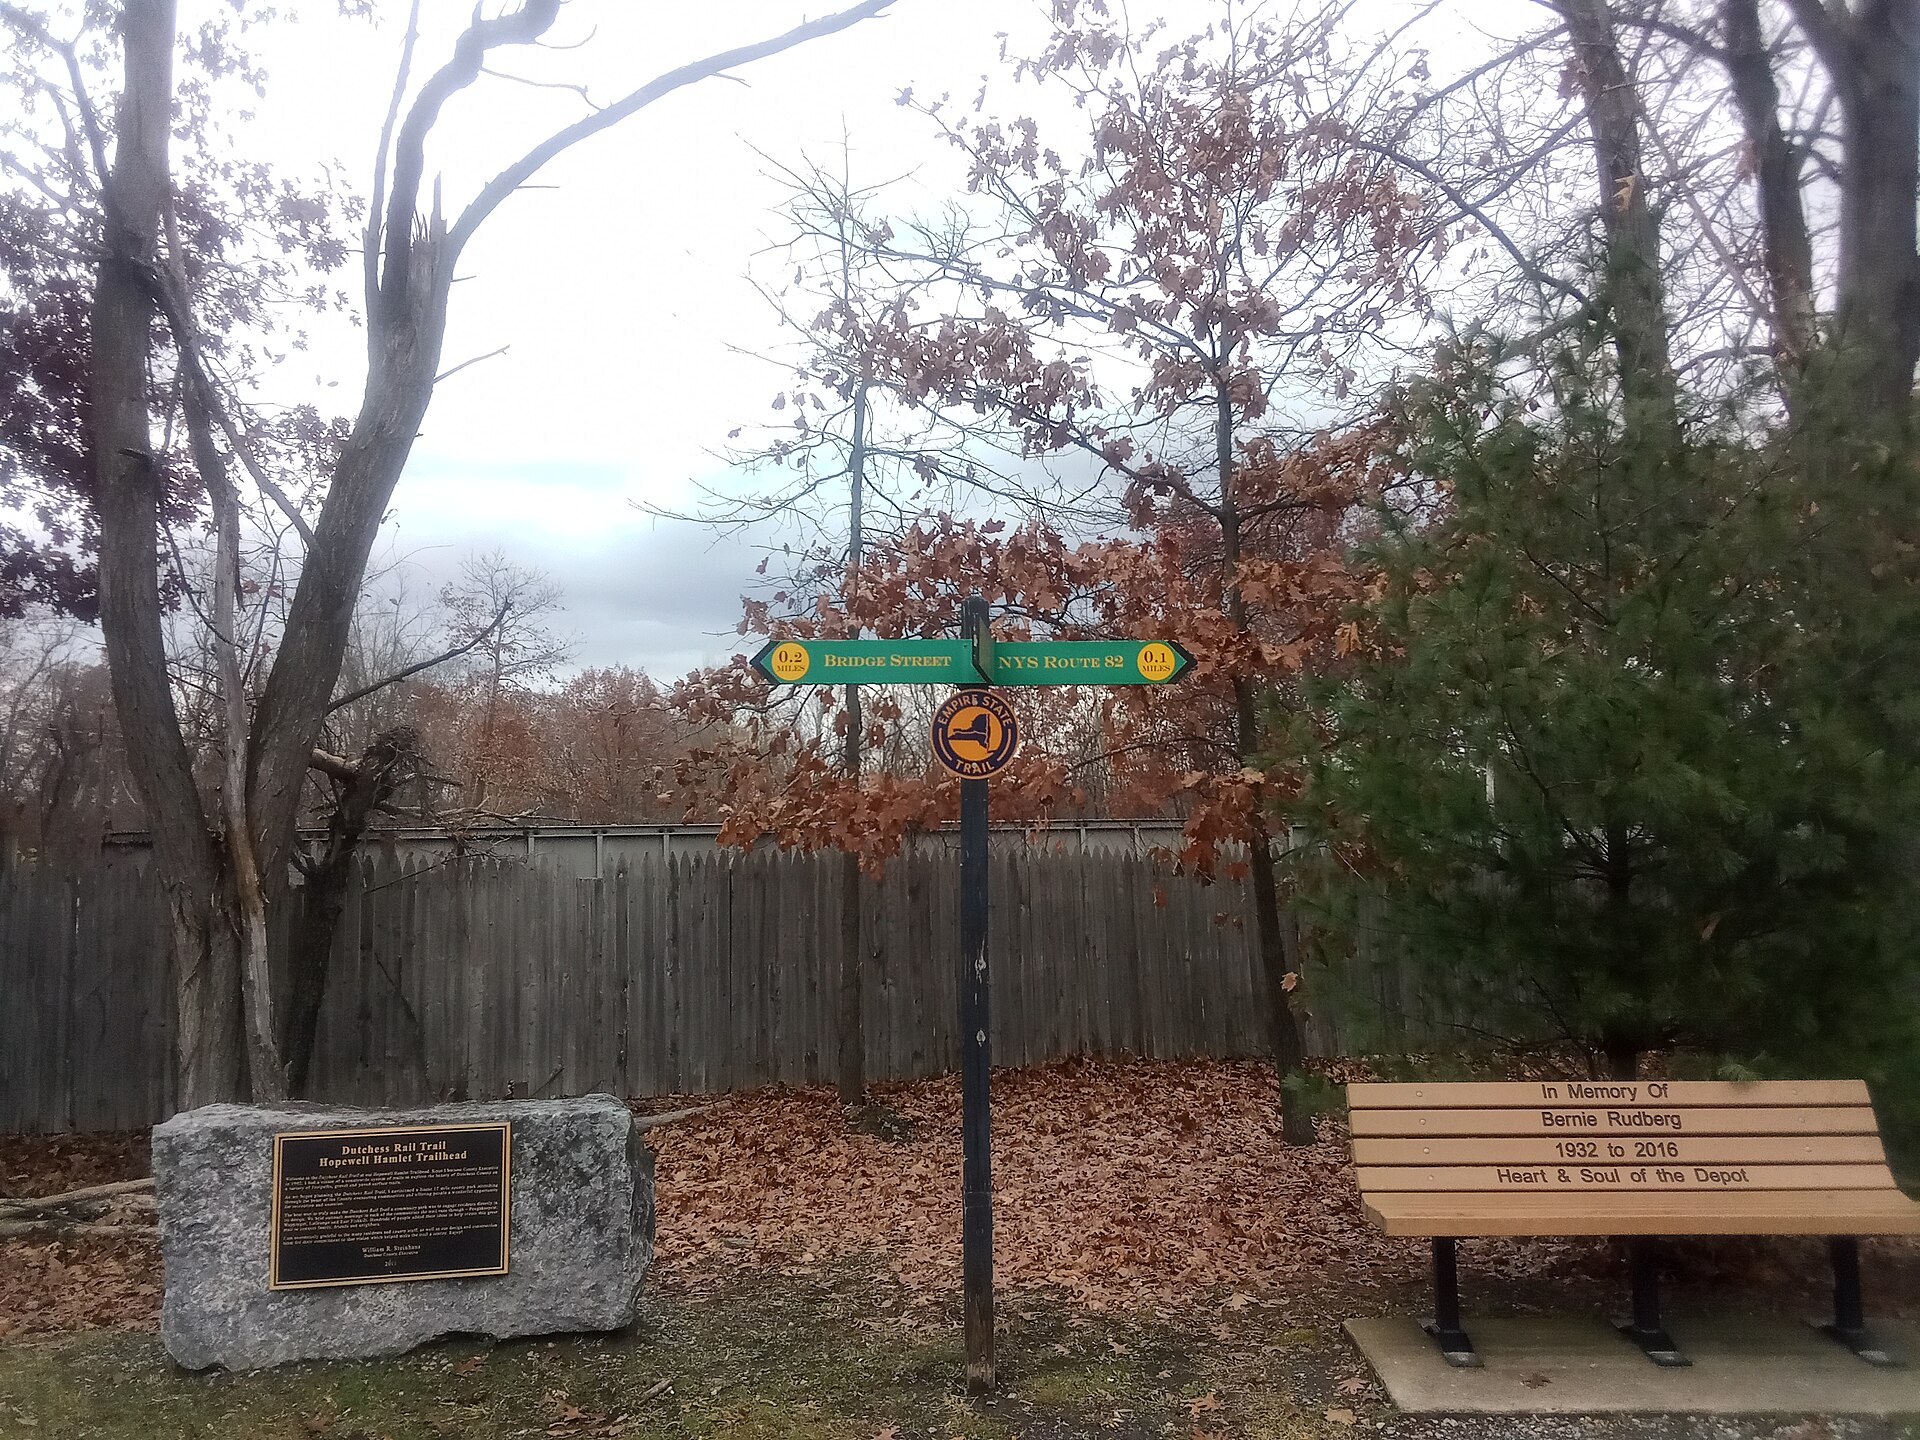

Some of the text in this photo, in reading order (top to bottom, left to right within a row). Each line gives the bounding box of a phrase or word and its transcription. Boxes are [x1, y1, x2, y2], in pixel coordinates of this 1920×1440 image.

[778, 650, 802, 663] 0.2
[824, 654, 951, 667] BRIDGE STREET
[999, 655, 1124, 669] NYS ROUTE 82
[1144, 650, 1166, 663] 0.1
[938, 694, 1013, 727] EMPIRE STATE
[955, 759, 995, 774] TRAIL
[1542, 1083, 1669, 1102] In Memory Of
[1542, 1112, 1682, 1130] Bernie Rudberg
[342, 1140, 446, 1156] Dutchess Rail Trail
[1555, 1142, 1679, 1158] 1932 to 2016
[319, 1150, 467, 1169] Hopewell Hamlet Trailhead
[1497, 1168, 1750, 1186] Heart & Soul of the Depot
